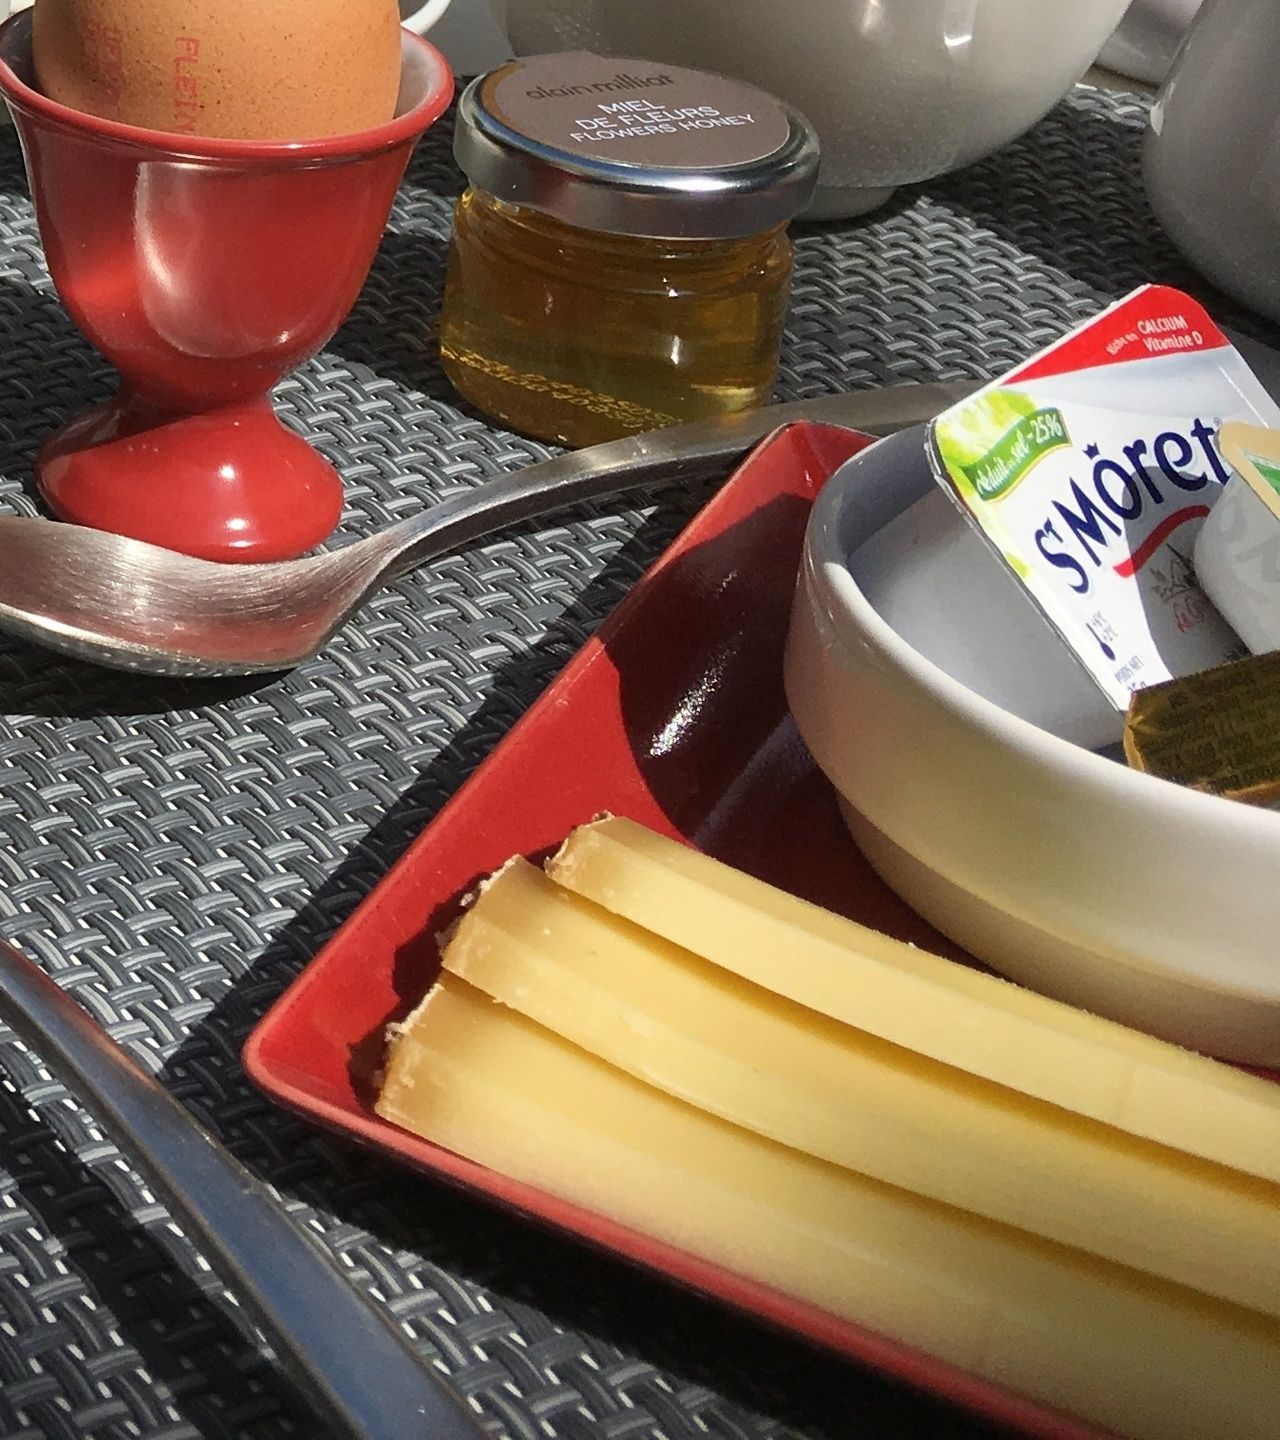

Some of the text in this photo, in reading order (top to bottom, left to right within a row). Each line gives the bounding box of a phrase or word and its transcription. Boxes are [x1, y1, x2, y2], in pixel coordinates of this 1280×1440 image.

[597, 98, 666, 115] MIEL
[569, 112, 756, 144] FLOWERS HONEY
[575, 105, 722, 132] DE FLEURS
[1137, 314, 1189, 336] CALCIUM
[1142, 332, 1203, 353] Vitamine D
